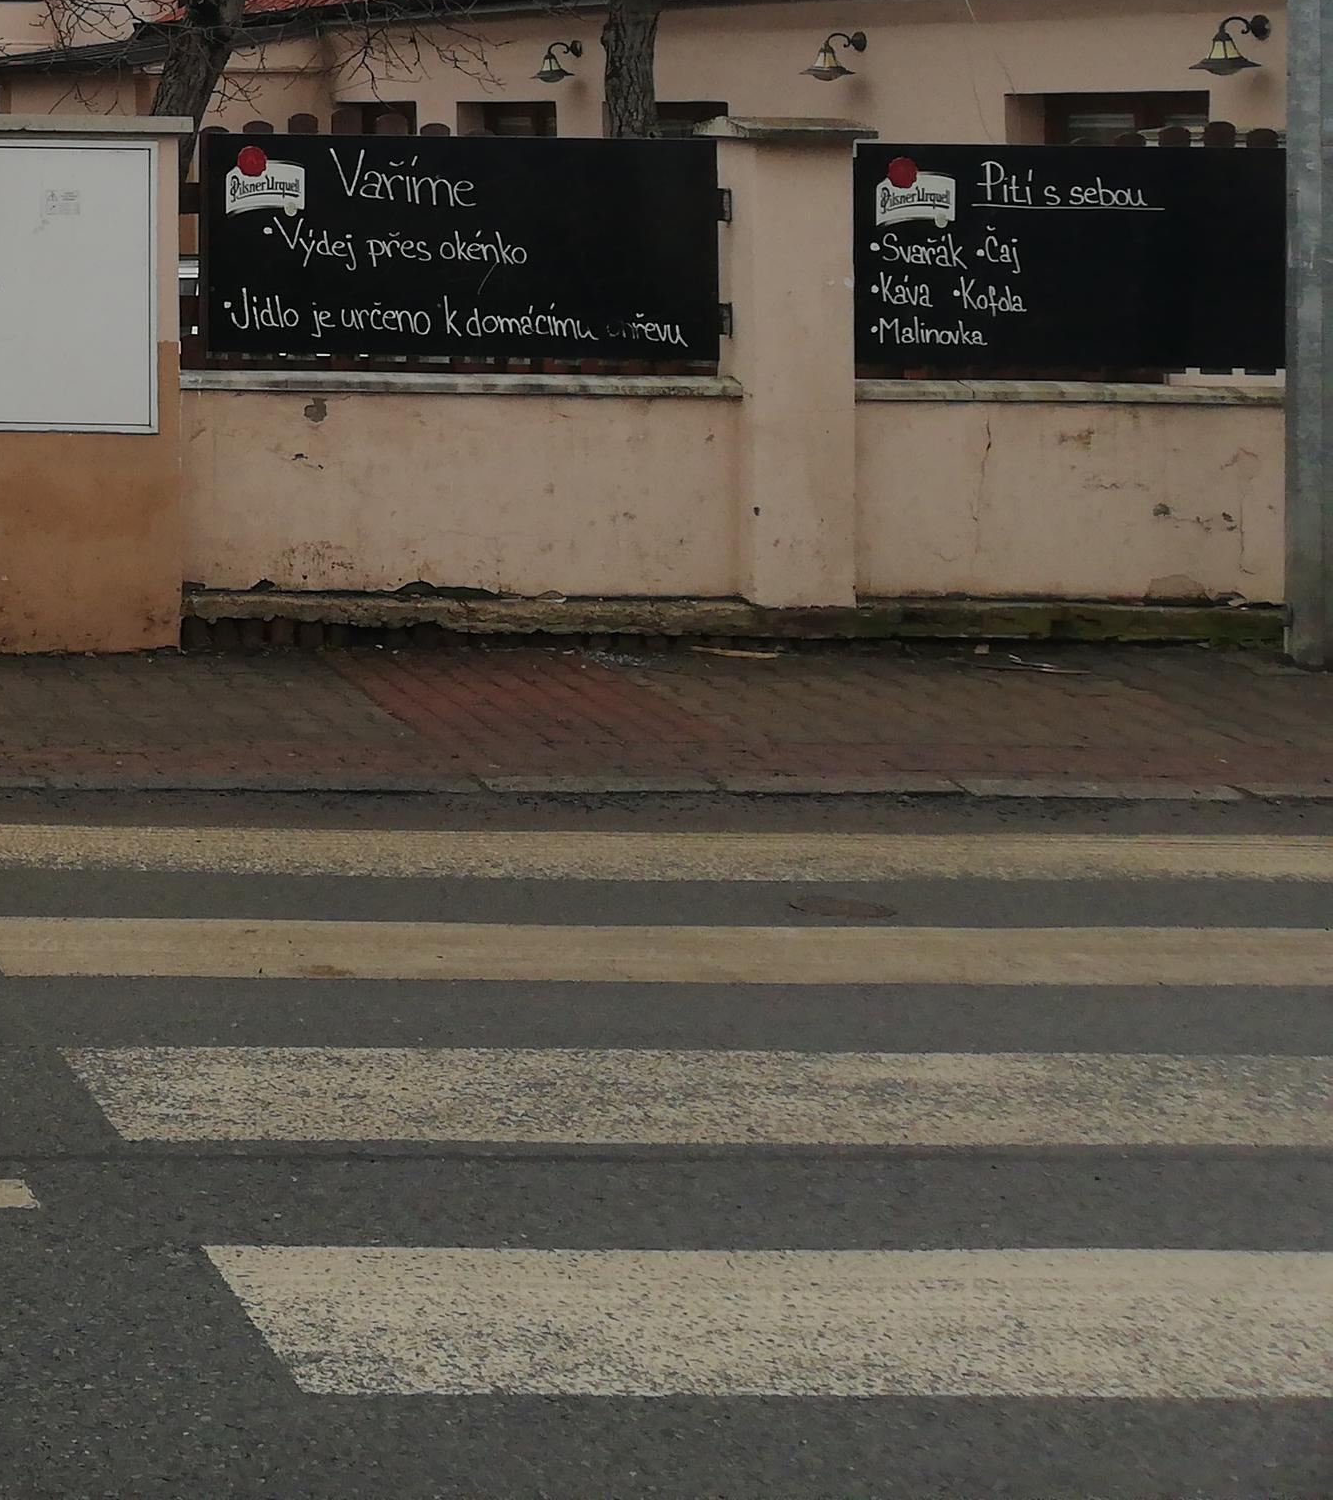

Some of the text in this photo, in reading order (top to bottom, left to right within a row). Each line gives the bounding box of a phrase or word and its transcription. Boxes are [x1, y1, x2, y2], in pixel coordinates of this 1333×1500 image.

[229, 175, 266, 203] Pilsner
[329, 148, 477, 207] Vaříme
[977, 160, 1148, 206] Pití s sebou
[880, 187, 917, 215] Pilsner
[273, 216, 527, 271] Výdej přes okénko
[882, 225, 1021, 274] Svařák Čaj
[880, 271, 1027, 317] Káva Kofola
[311, 301, 336, 337] je
[341, 302, 431, 335] určeno
[444, 295, 462, 337] k
[466, 302, 599, 341] domácímu
[879, 316, 988, 345] Malinovka
